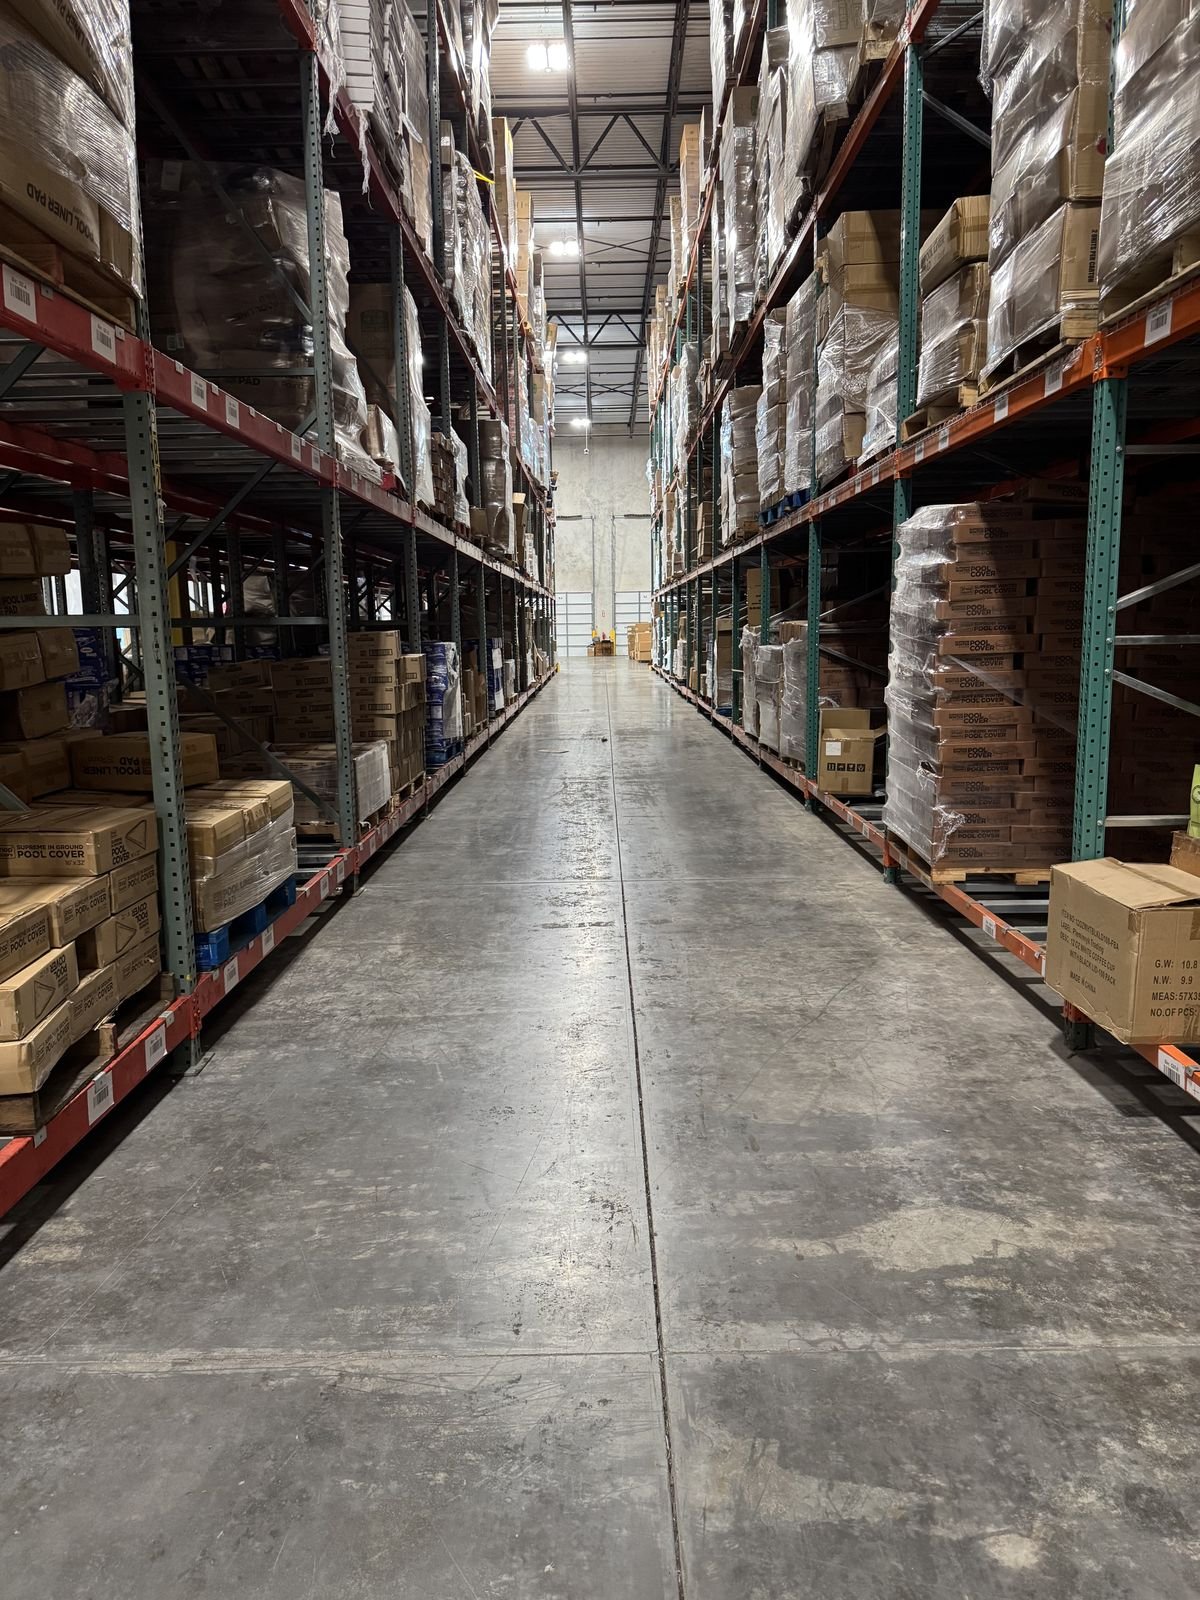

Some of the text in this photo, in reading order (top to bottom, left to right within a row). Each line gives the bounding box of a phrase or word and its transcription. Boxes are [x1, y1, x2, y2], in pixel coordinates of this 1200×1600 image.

[26, 182, 48, 207] PAD
[48, 196, 74, 226] LINER
[120, 756, 140, 766] PAD
[113, 766, 141, 775] POOL
[17, 850, 47, 859] POOL
[48, 850, 85, 859] COVER
[111, 844, 126, 857] POOL
[112, 851, 130, 866] COVER
[90, 893, 107, 908] COVER
[131, 901, 148, 917] COVER
[135, 909, 149, 923] POOL
[10, 936, 28, 953] POOL
[28, 925, 46, 941] COVER
[50, 954, 66, 972] COVER
[1079, 954, 1091, 969] BLACK
[1092, 951, 1107, 968] COFFEE
[1107, 961, 1116, 972] CUP
[1154, 959, 1198, 969] G.W: 10.8
[55, 964, 67, 979] POOL
[1153, 975, 1193, 985] N.W: 9.9
[97, 983, 114, 999] COVER
